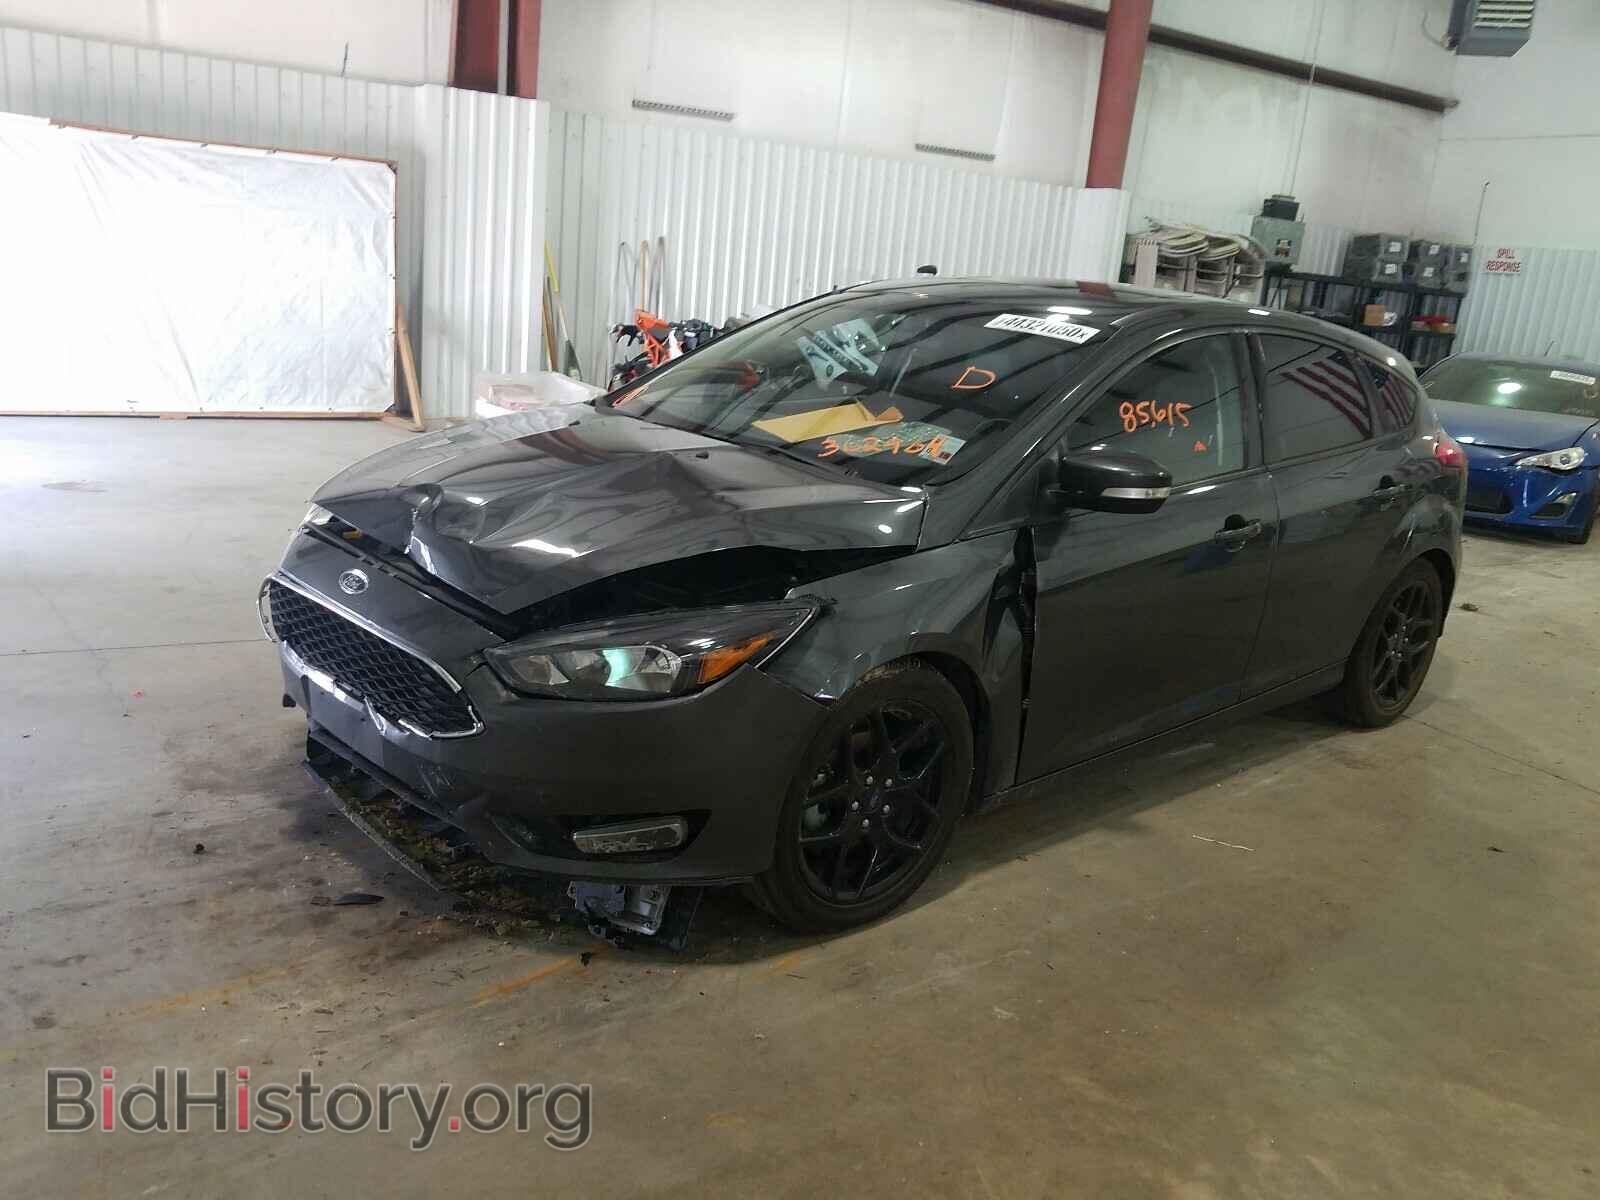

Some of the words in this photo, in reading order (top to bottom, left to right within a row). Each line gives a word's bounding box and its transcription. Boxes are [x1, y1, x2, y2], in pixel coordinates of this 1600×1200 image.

[1497, 248, 1515, 259] SPILL
[1486, 260, 1521, 273] RESPONSE
[952, 366, 997, 390] D
